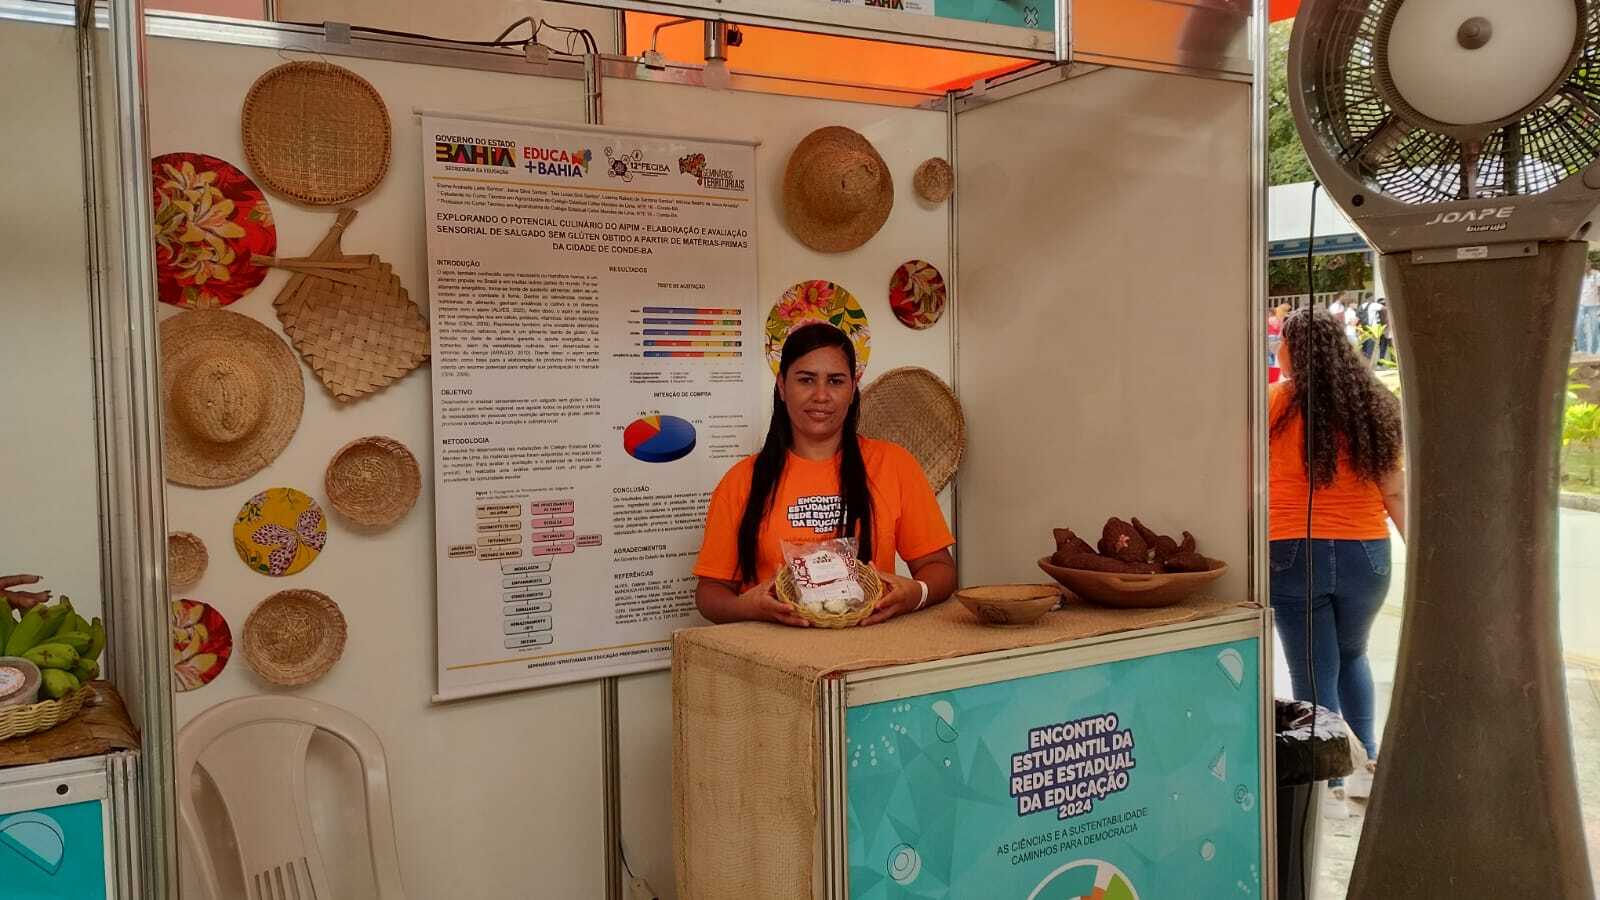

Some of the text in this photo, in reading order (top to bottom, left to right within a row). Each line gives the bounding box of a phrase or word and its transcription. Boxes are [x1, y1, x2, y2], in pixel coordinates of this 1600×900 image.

[435, 135, 474, 145] GOVERNO
[488, 139, 516, 148] ESTADO
[436, 142, 516, 168] BAHIA
[523, 147, 570, 163] EDUCA
[642, 163, 671, 172] FECIBA
[704, 177, 745, 189] TERRITORIAIS
[1425, 205, 1516, 226] JOAPE
[436, 213, 499, 224] EXPLORANDO
[501, 216, 508, 224] O
[510, 216, 557, 227] POTENCIAL
[559, 219, 603, 230] CULINÁRIO
[605, 222, 617, 231] DO
[619, 223, 640, 231] AIPIM
[647, 225, 699, 237] ELABORAÇÃO
[708, 228, 748, 239] AVALIAÇÃO
[436, 225, 487, 235] SENSORIAL
[490, 227, 501, 235] DE
[504, 229, 546, 238] SALGADO
[549, 230, 566, 239] SEM
[568, 230, 600, 241] GLÚTEN
[602, 233, 633, 243] OBTIDO
[641, 236, 669, 244] PARTIR
[671, 237, 681, 245] DE
[552, 242, 653, 255] DA CIDADE DE CONDE-BA
[436, 259, 480, 268] INTRODUÇÃO
[653, 391, 681, 399] INTENÇÃO
[442, 437, 490, 445] METODOLOGIA
[613, 485, 650, 494] CONCLUSÃO
[787, 512, 812, 520] REDE
[791, 519, 806, 527] DA
[613, 544, 667, 555] AGRADECIMENTOS
[614, 570, 654, 580] REFERÊNCIAS
[1029, 714, 1118, 749] ENCONTRO
[1012, 731, 1134, 774] ESTUDANTIL DA
[1011, 751, 1135, 795] REDE ESTADUAL
[1019, 770, 1128, 814] DA EDUCAÇÃO
[1059, 799, 1092, 819] 2024
[997, 807, 1149, 857] AS CIÊNCIAS E A SUSTENTABILIDADE
[1011, 823, 1139, 866] CAMINHOS PARA DEMOCRACIA
